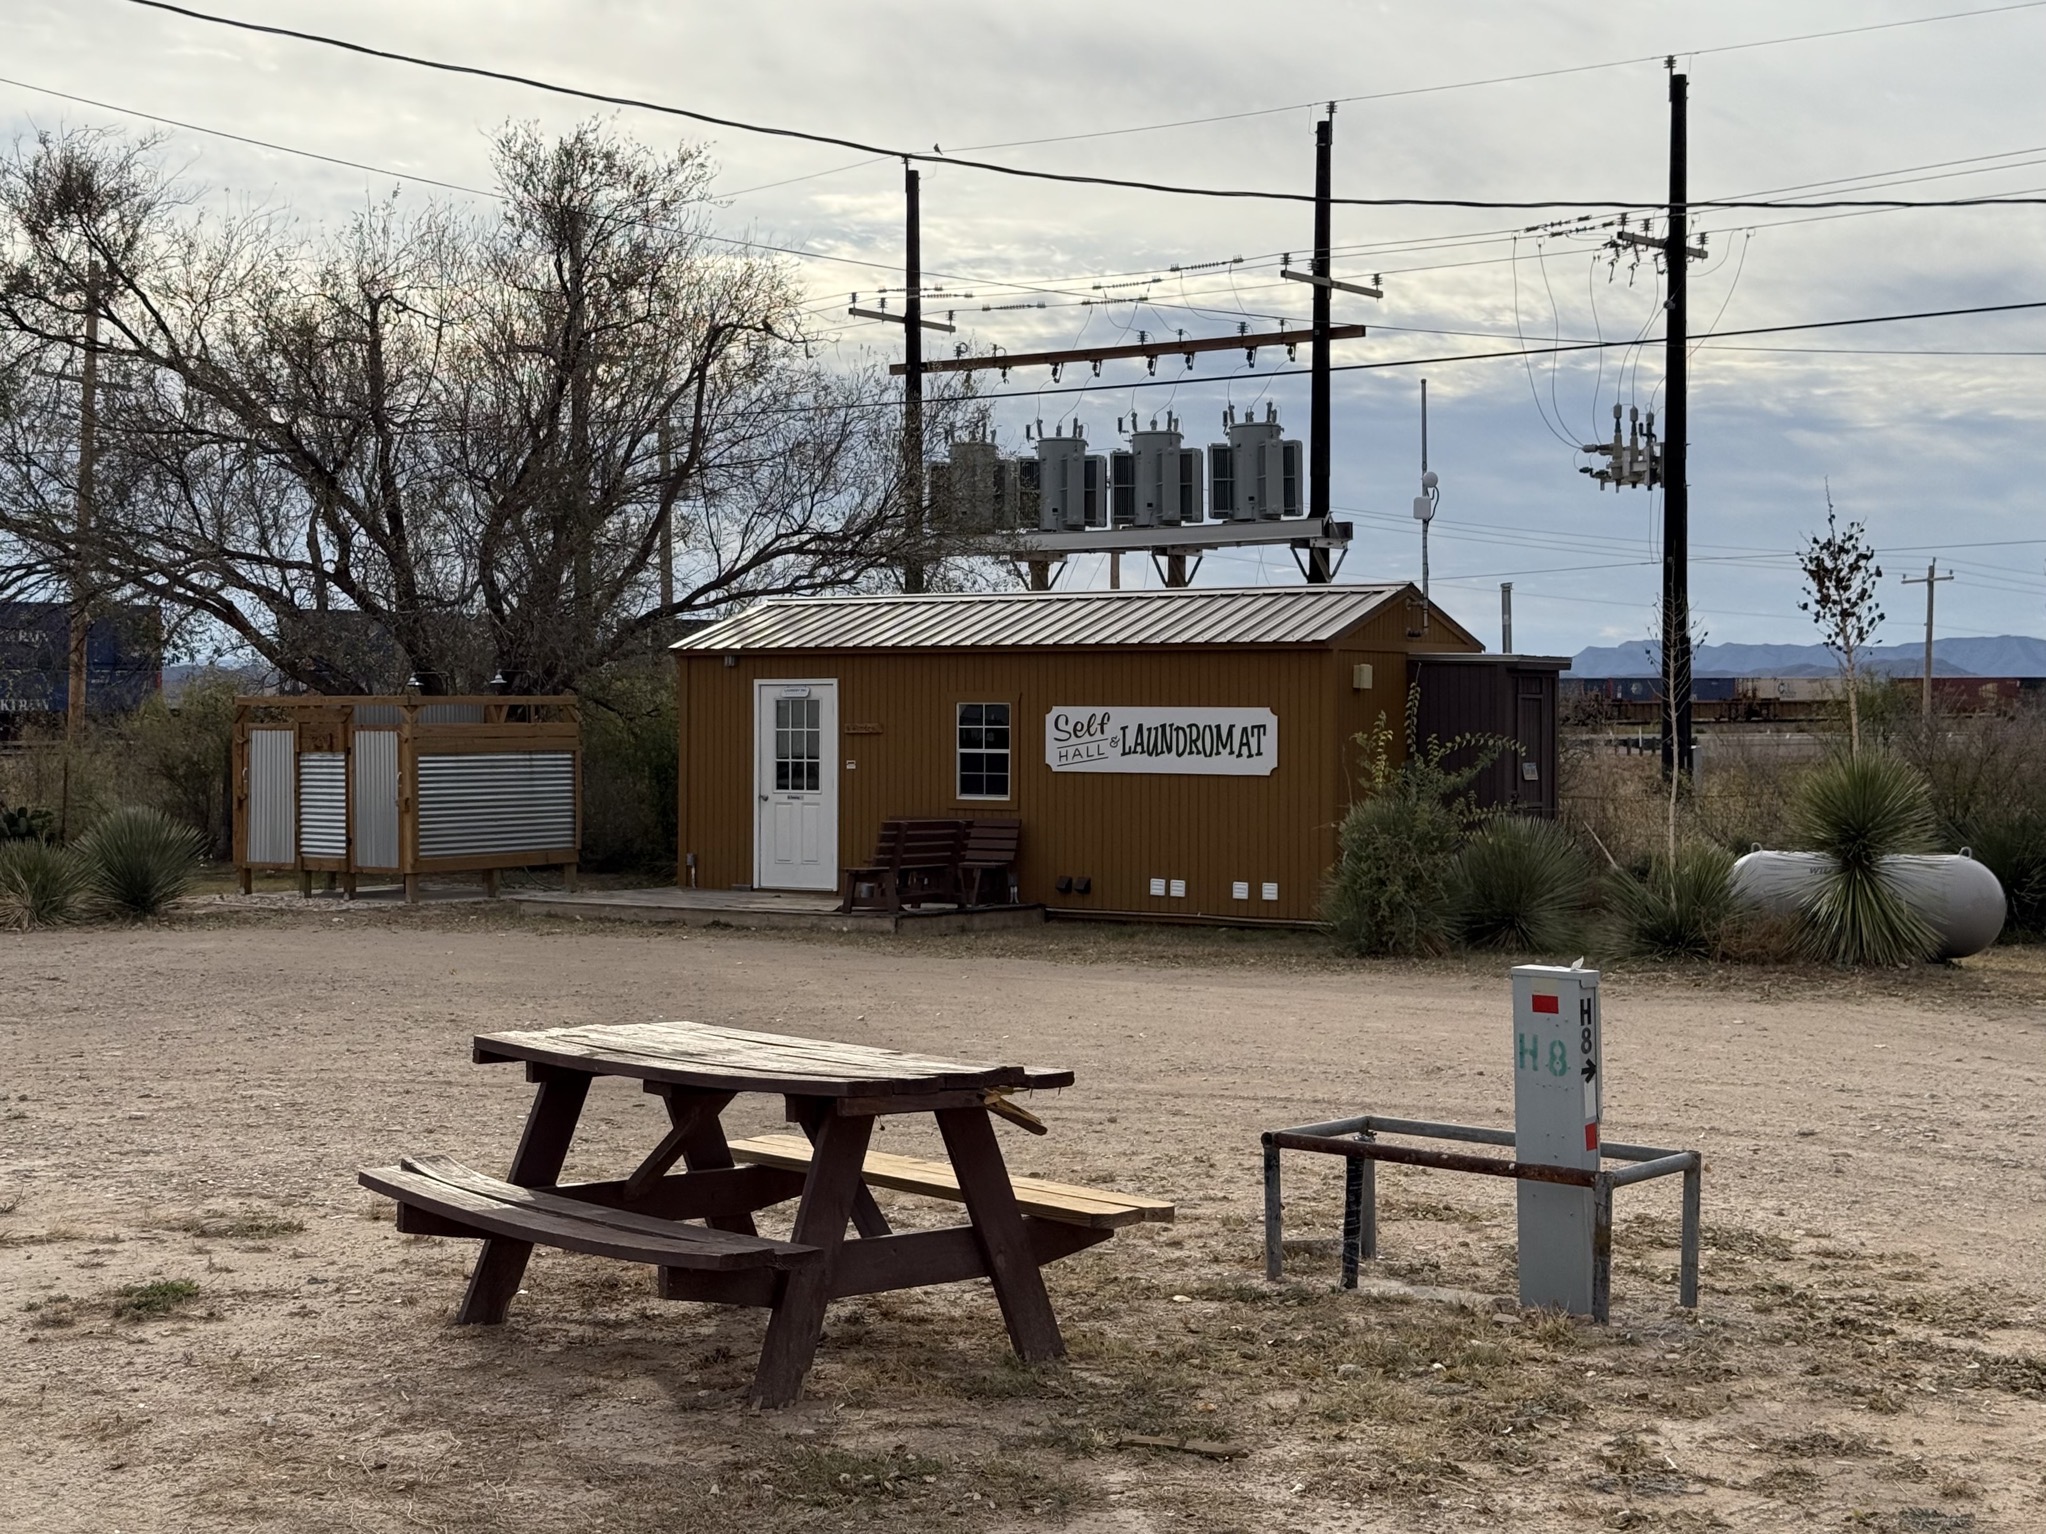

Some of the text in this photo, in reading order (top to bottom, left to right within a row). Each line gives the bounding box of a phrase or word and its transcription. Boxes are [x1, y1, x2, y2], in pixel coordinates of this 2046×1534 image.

[1053, 711, 1111, 742] Self
[1110, 722, 1267, 759] & LAUNDROMAT
[1058, 743, 1105, 762] HALL
